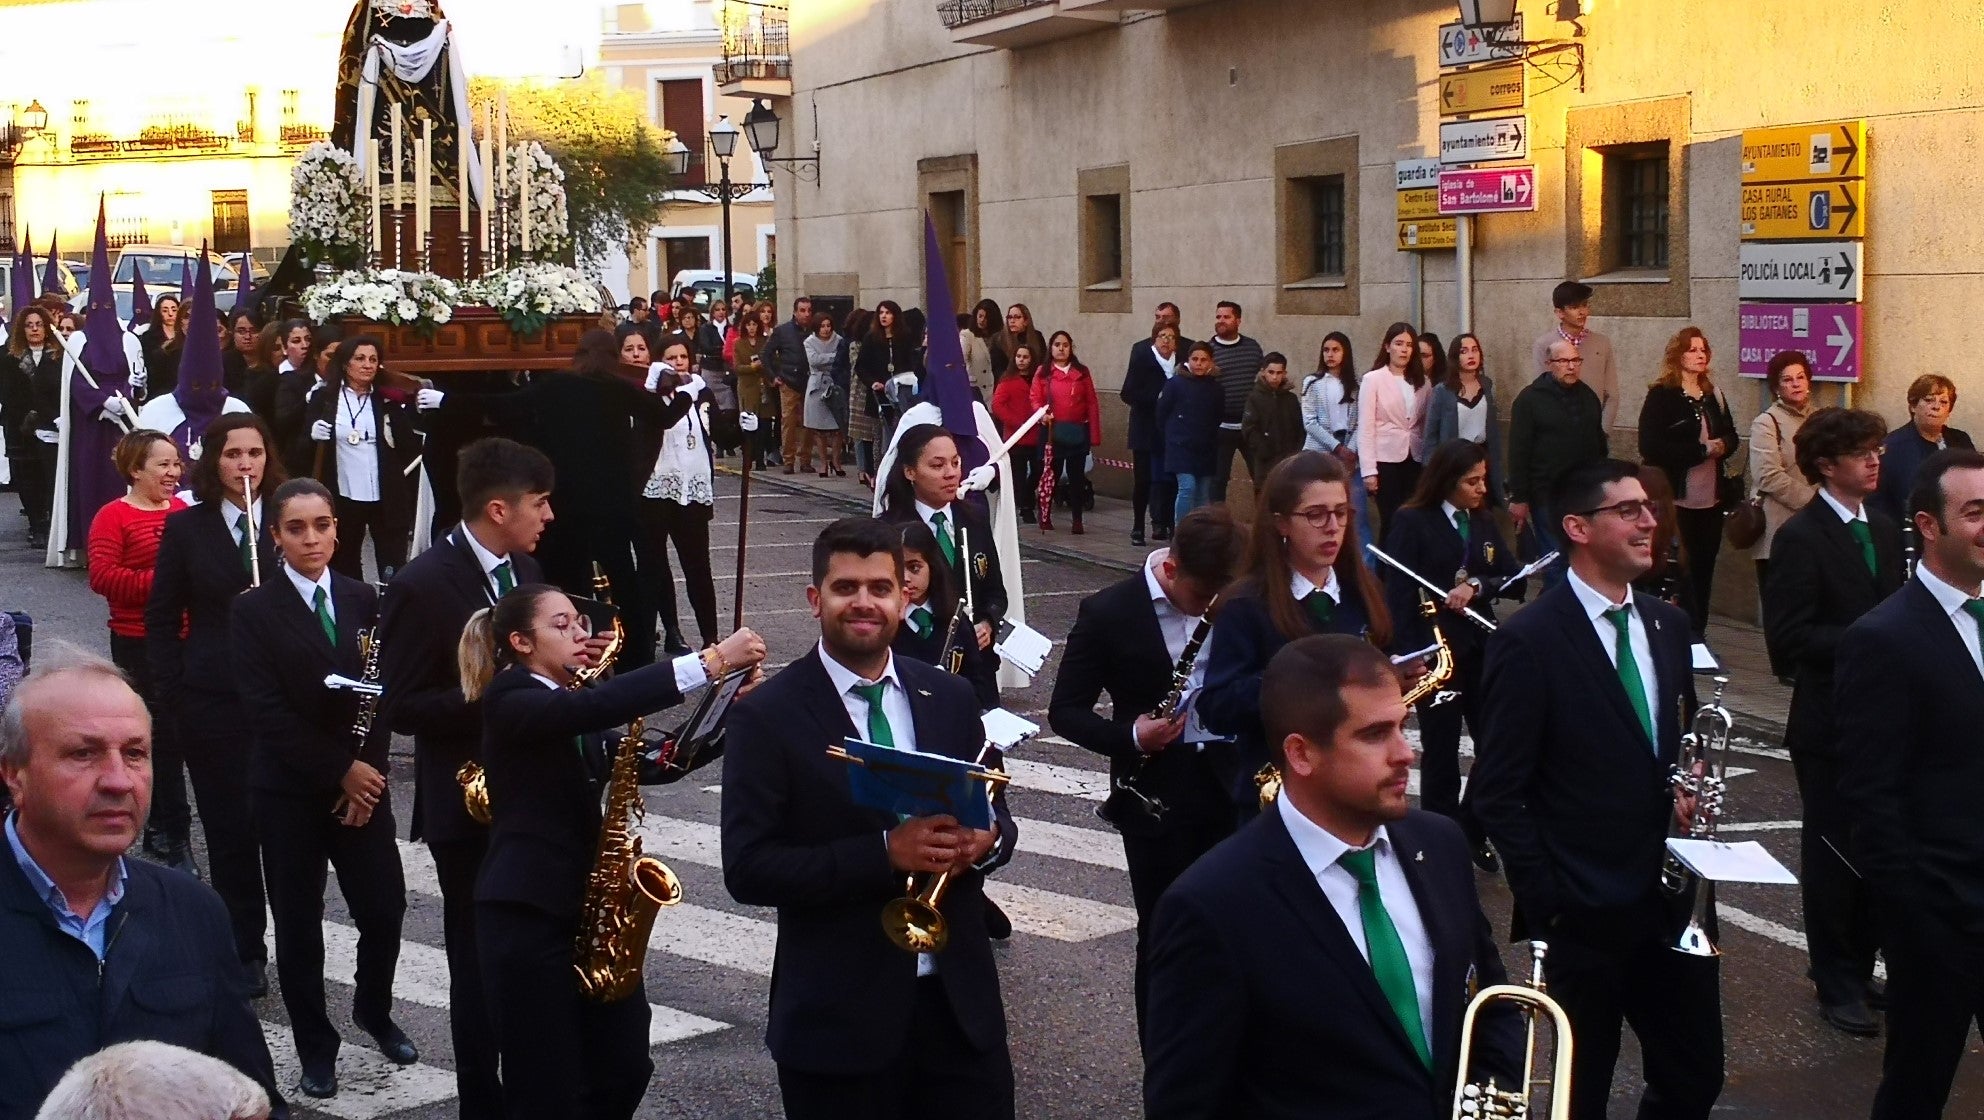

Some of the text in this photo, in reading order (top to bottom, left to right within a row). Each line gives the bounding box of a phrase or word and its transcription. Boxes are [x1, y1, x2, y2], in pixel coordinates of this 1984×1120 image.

[1490, 82, 1521, 96] correos
[1442, 133, 1495, 153] ayuntamiento
[1743, 142, 1801, 160] AYUNTAMIENTO
[1398, 165, 1427, 185] guardia
[1441, 178, 1475, 192] iglesia de
[1442, 190, 1499, 206] San Bartolomé
[1743, 187, 1793, 204] CASA RURAL
[1742, 205, 1798, 221] LOS GAITANES
[1741, 258, 1816, 281] POLICÍA LOCAL
[1741, 315, 1790, 330] BIBLIOTECA
[1741, 347, 1762, 362] CASA
